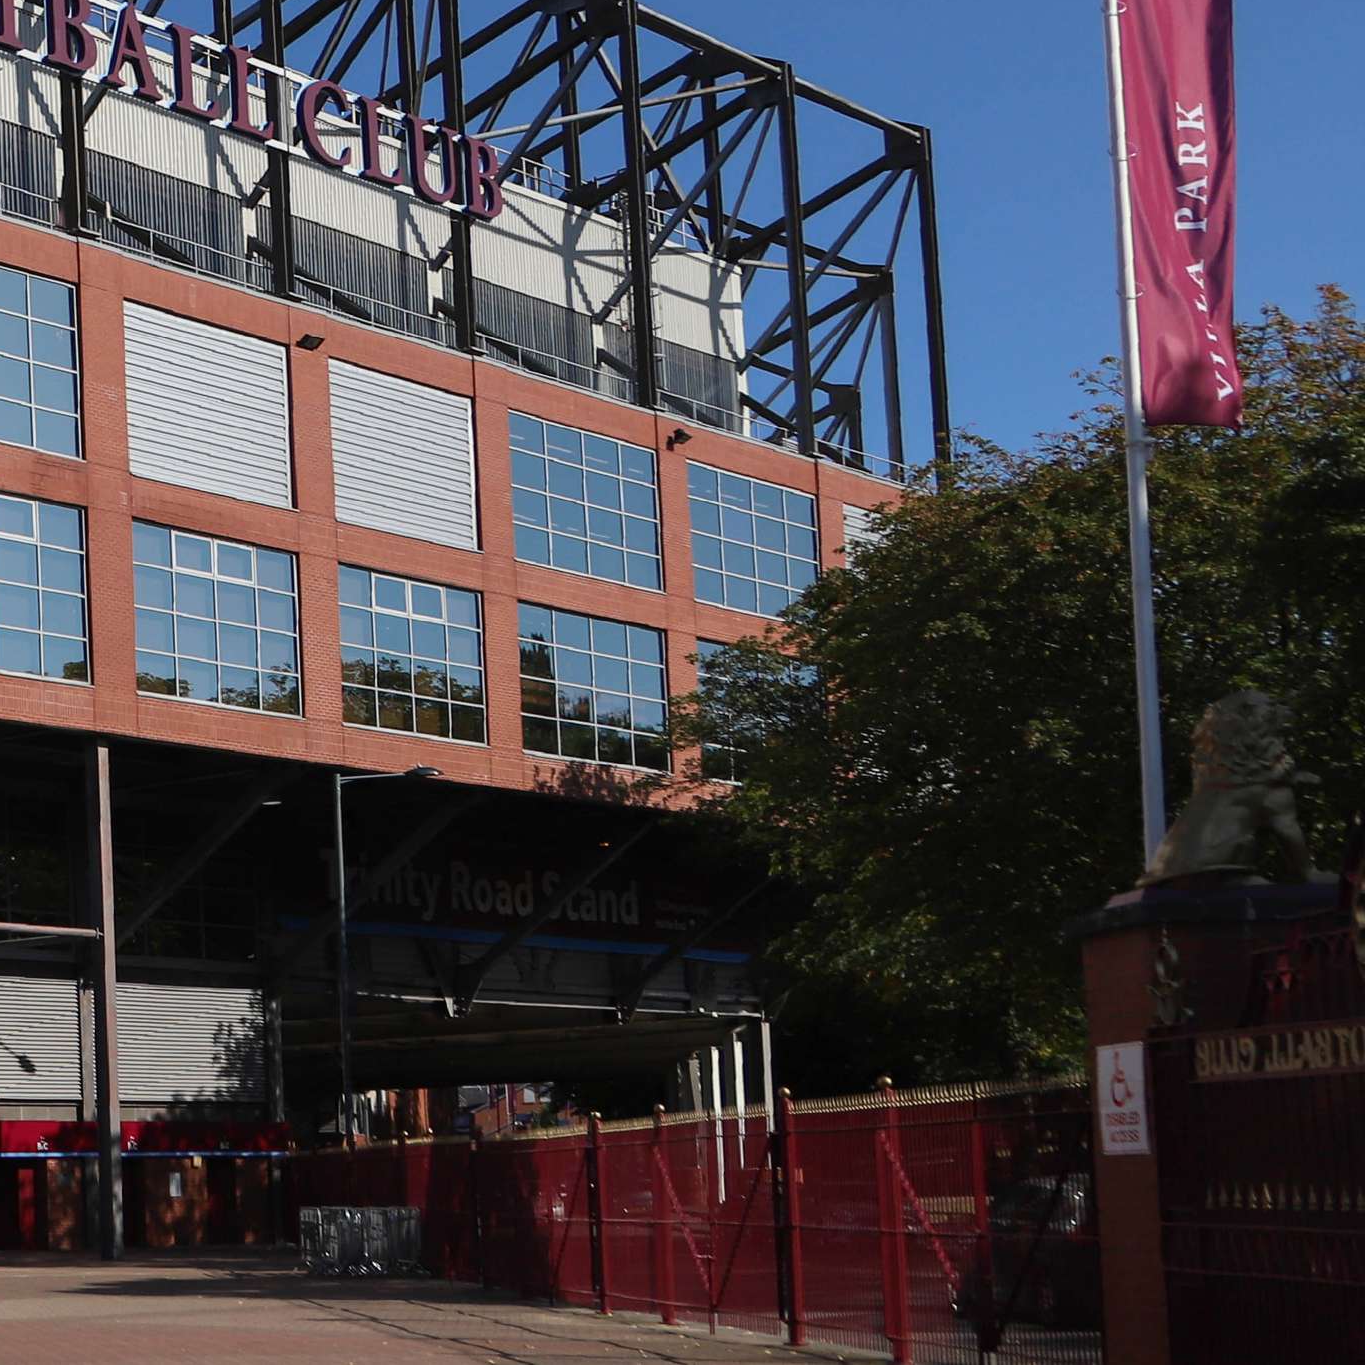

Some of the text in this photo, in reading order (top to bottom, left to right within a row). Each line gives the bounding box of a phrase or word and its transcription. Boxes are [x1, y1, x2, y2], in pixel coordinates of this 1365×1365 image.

[296, 79, 503, 221] CLUB
[1175, 102, 1209, 233] PARK
[450, 859, 533, 916] Road
